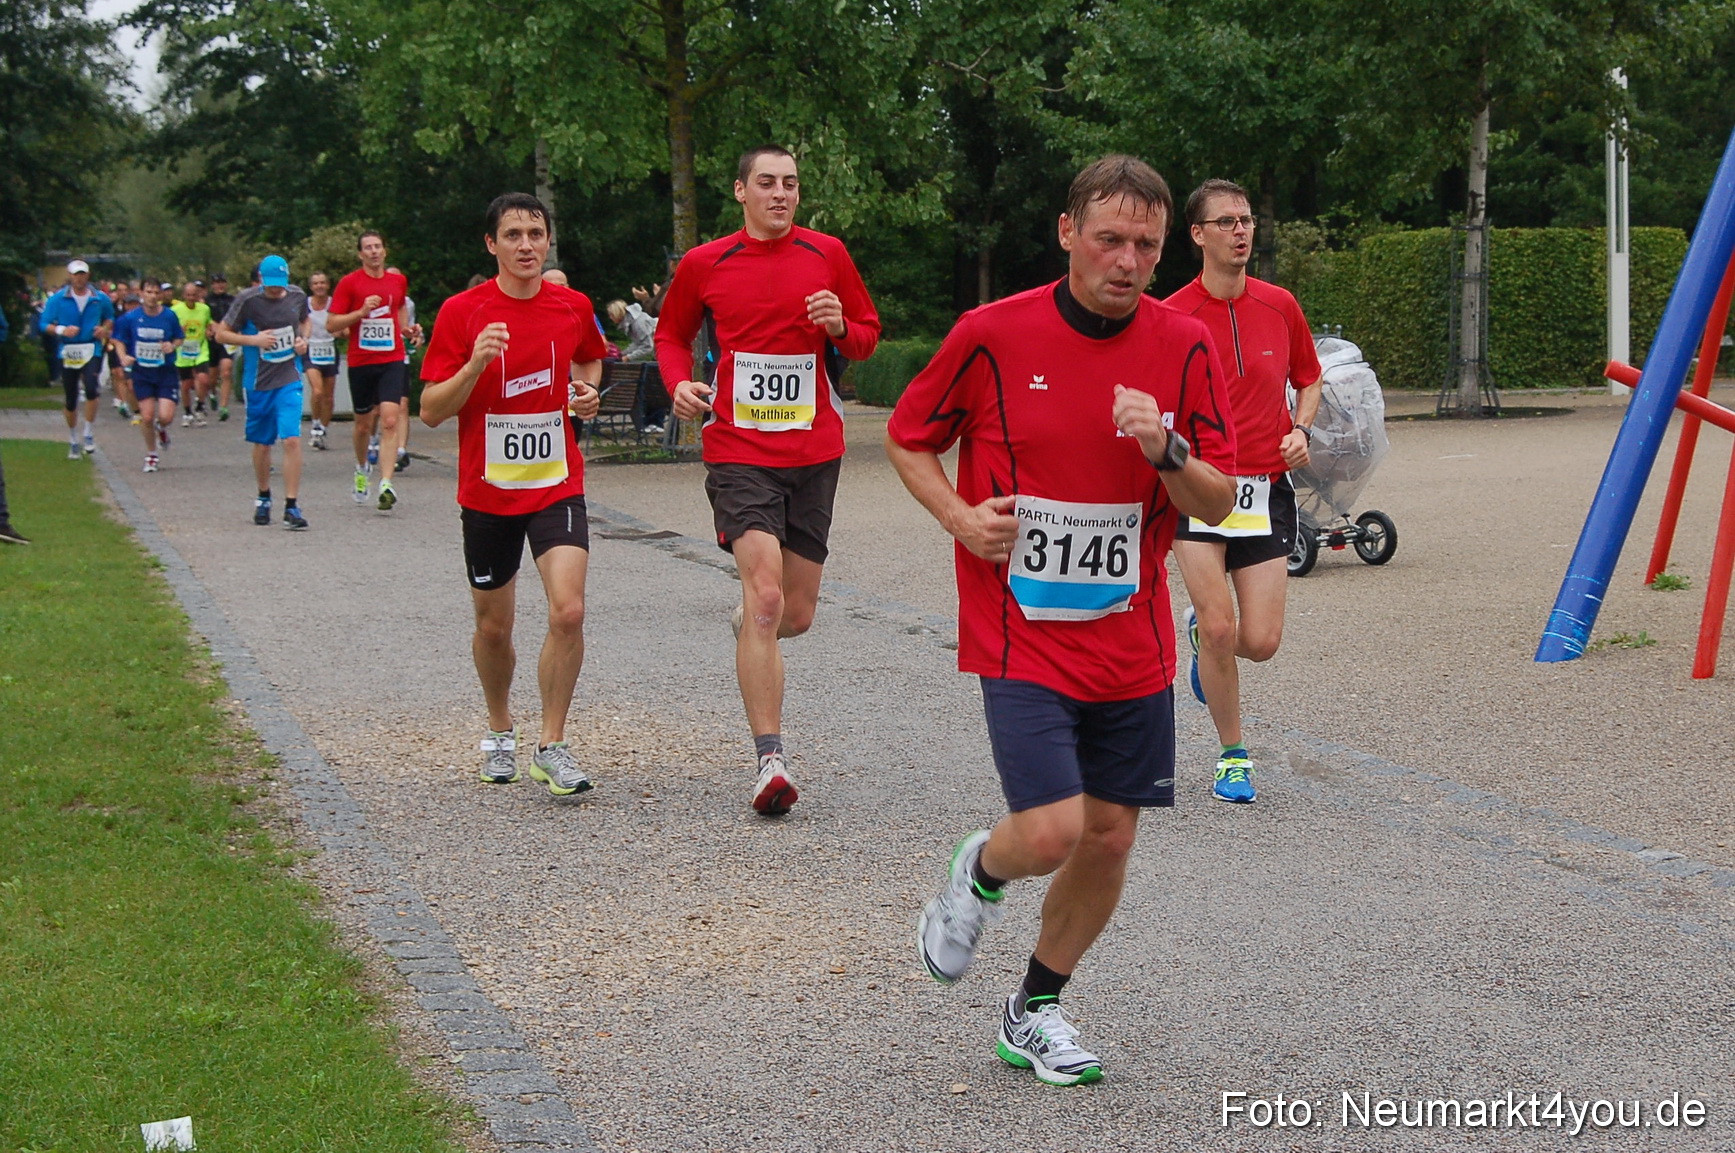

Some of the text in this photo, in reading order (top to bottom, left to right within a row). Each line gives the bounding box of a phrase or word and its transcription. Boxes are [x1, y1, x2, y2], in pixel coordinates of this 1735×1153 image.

[363, 326, 390, 338] 2304
[264, 335, 292, 351] 14
[736, 360, 803, 370] PARTL Neumarkt
[749, 373, 801, 402] 390
[751, 408, 796, 420] Matthias
[487, 420, 552, 429] PARTL Neumarkt
[504, 431, 552, 460] 600
[1235, 483, 1254, 510] 8
[1017, 507, 1122, 528] PARTL Neumarkt
[1023, 528, 1129, 578] 3146
